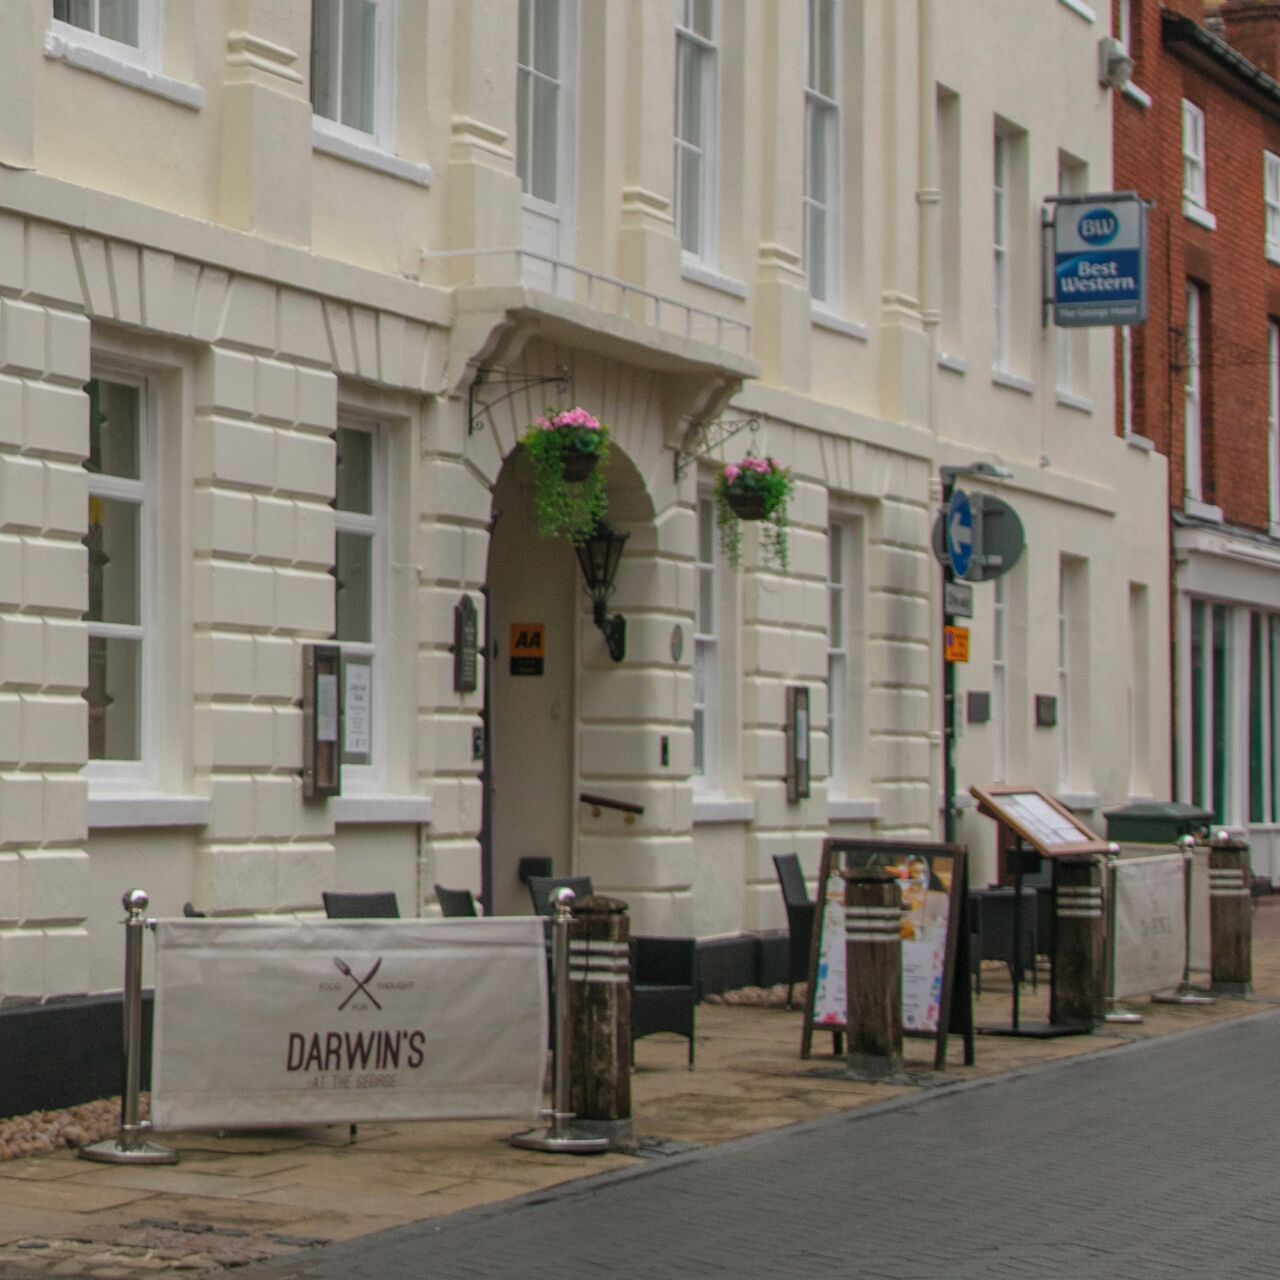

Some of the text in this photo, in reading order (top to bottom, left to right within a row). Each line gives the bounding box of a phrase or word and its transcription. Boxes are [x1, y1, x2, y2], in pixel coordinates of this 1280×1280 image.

[1081, 219, 1115, 236] BW
[1078, 261, 1118, 276] Best
[1061, 277, 1134, 293] Western
[514, 631, 541, 648] AA
[287, 1030, 426, 1071] DARWIN'S
[332, 1075, 351, 1089] THE
